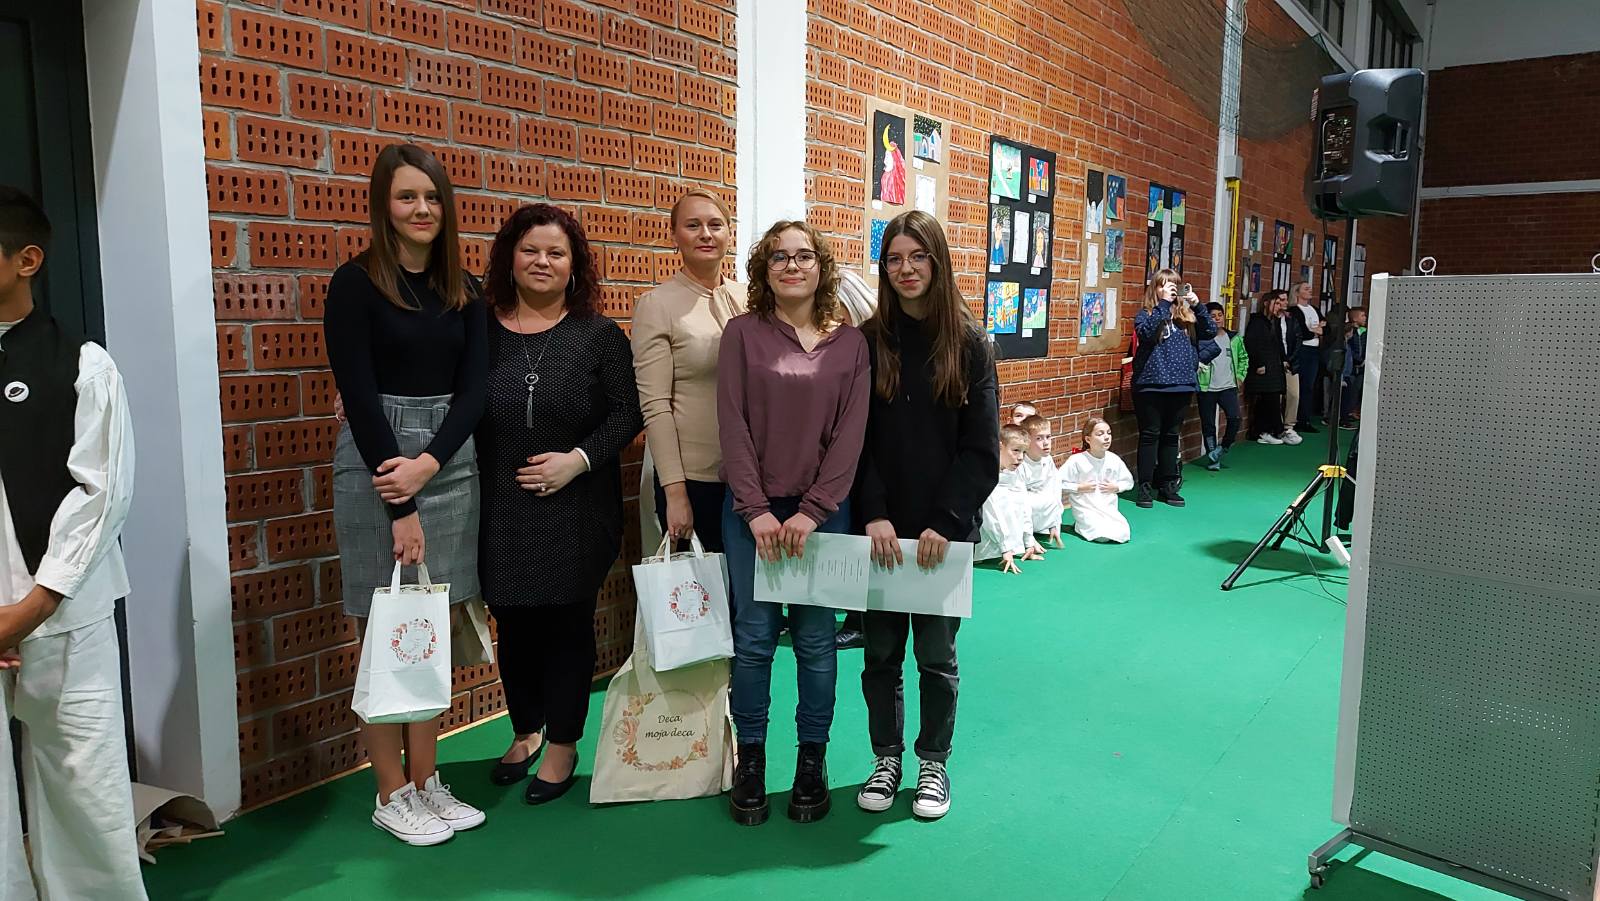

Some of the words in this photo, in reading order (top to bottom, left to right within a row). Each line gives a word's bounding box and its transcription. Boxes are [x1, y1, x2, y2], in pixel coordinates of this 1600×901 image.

[657, 714, 683, 724] Deca,
[645, 729, 670, 741] moja
[670, 727, 696, 737] deca
